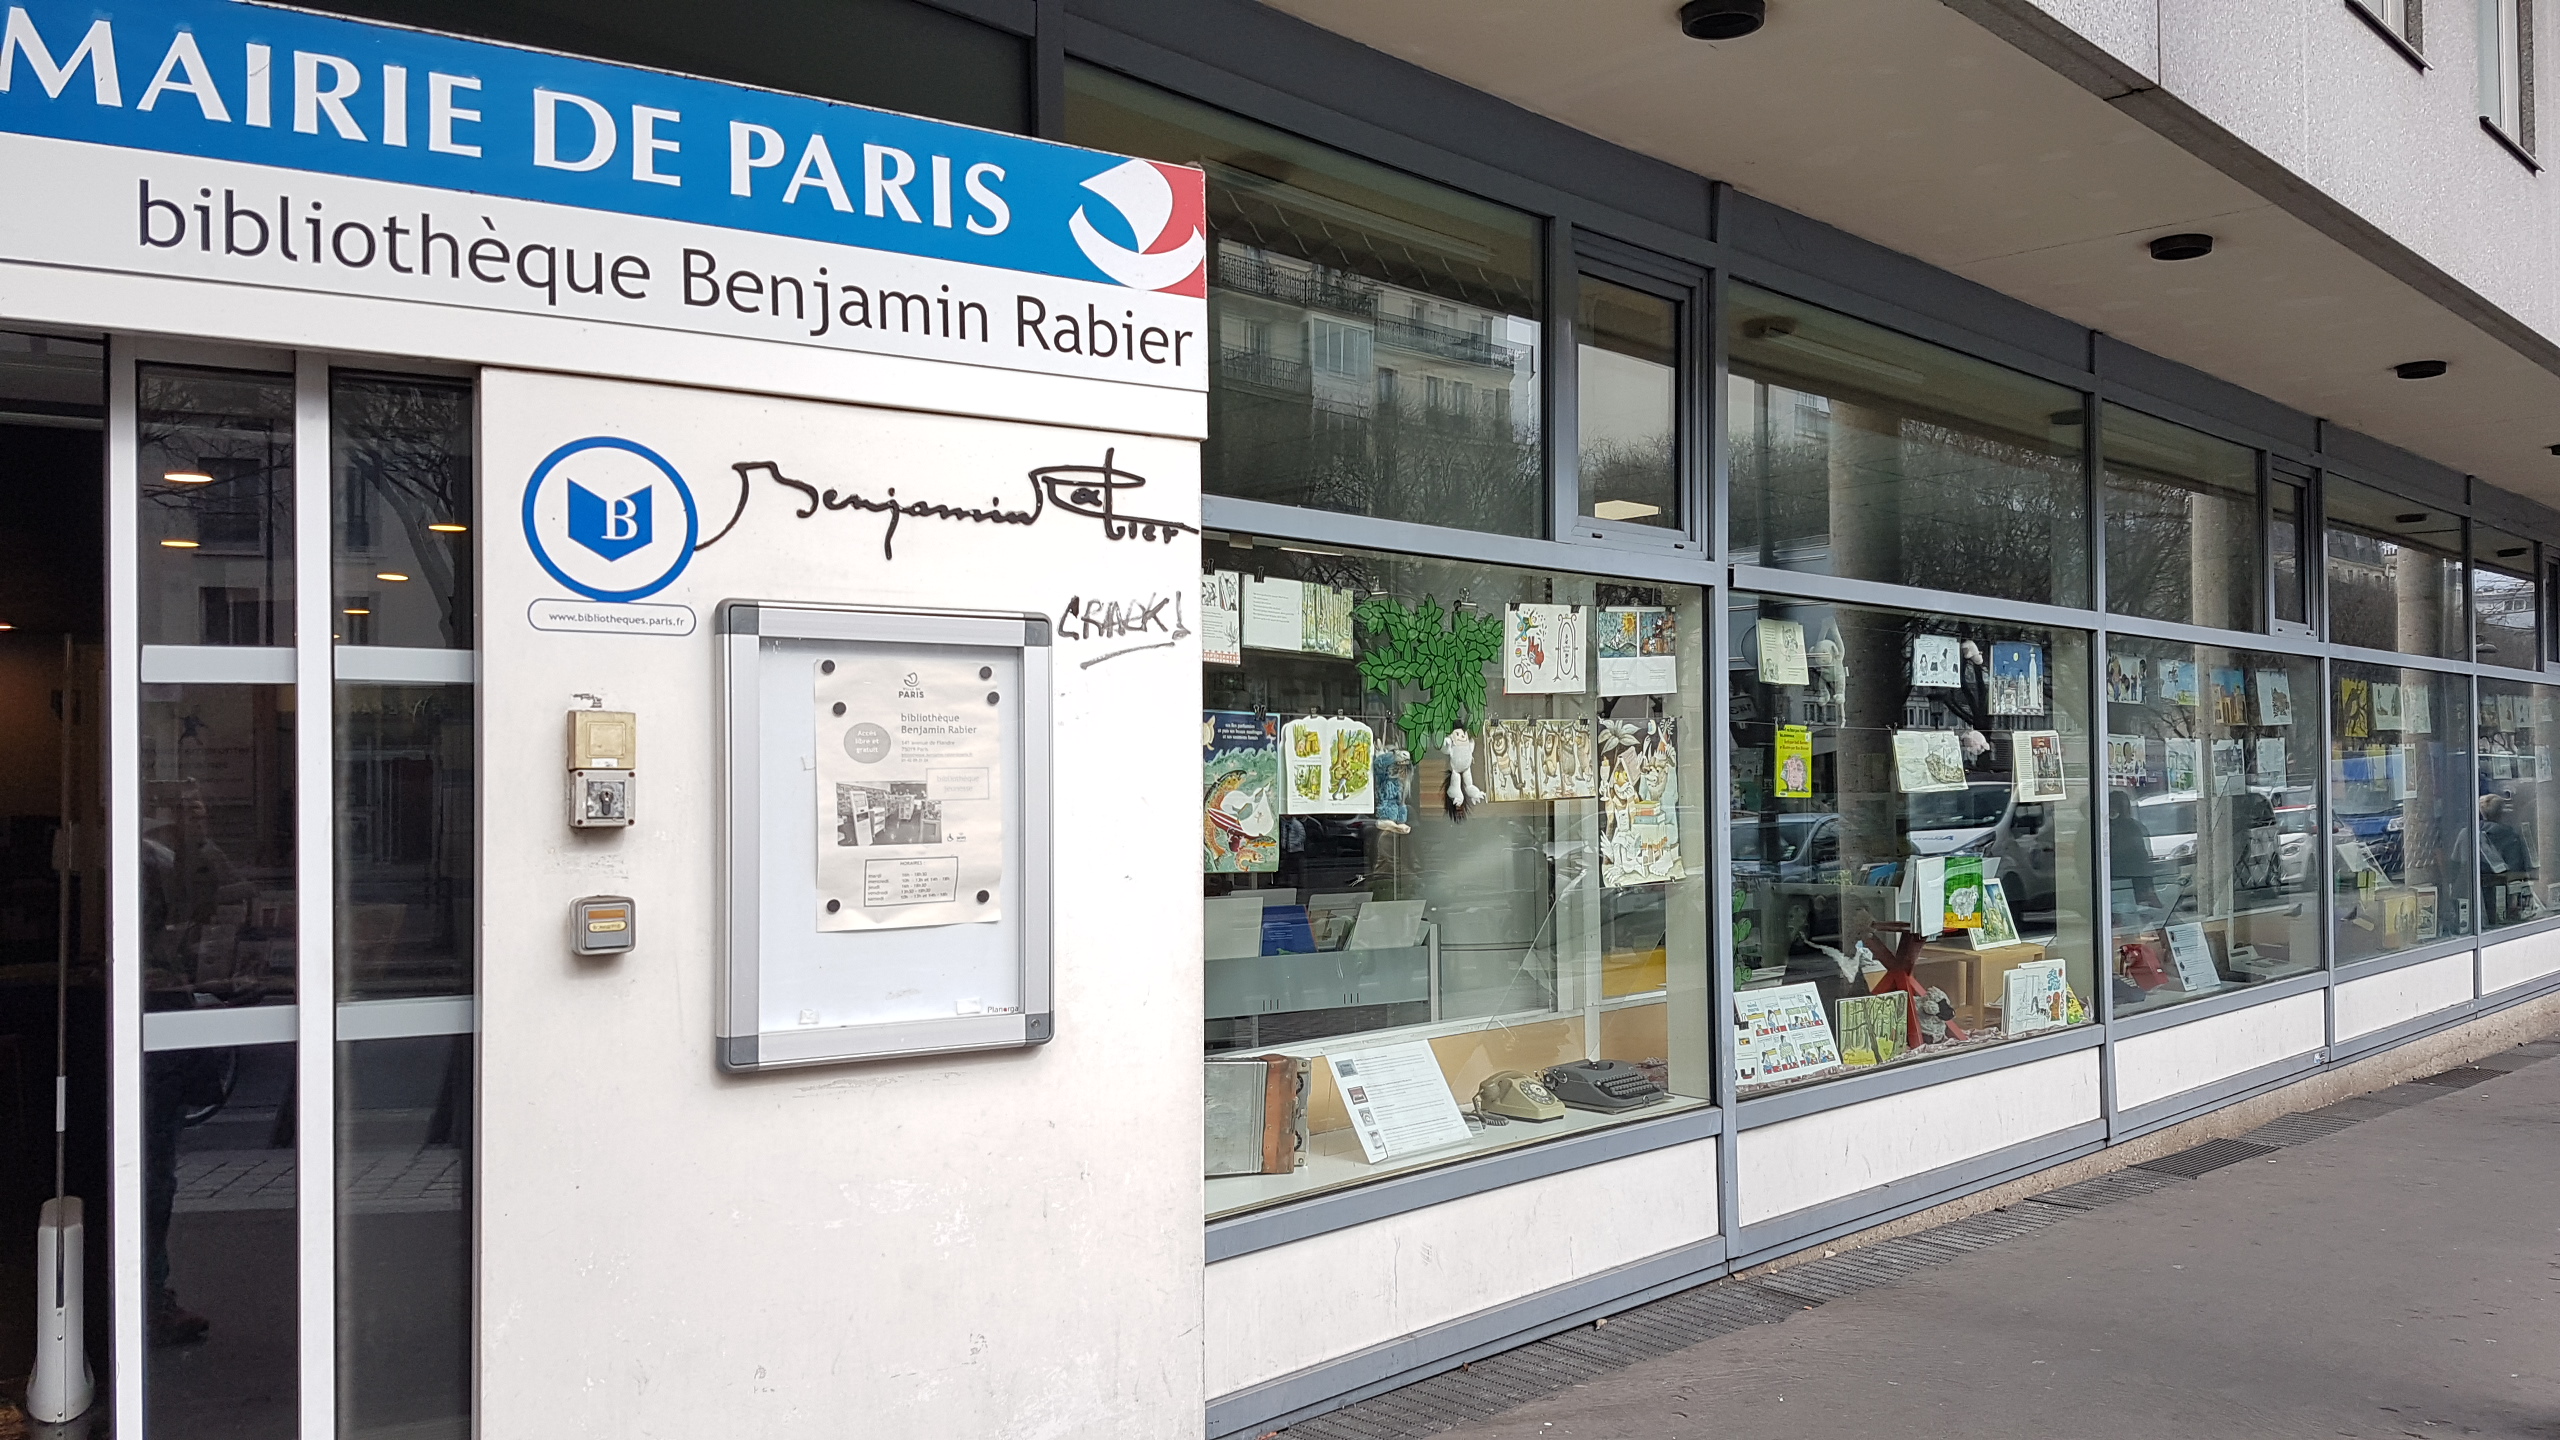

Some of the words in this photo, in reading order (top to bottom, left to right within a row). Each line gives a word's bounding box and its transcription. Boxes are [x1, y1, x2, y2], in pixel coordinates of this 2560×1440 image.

[0, 6, 483, 158] MAIRIE
[533, 87, 682, 187] DE
[729, 120, 1011, 236] PARIS
[139, 178, 652, 306] bibliothèque
[682, 247, 988, 343] Benjamin
[1017, 295, 1194, 367] Rabier
[548, 613, 685, 627] www.bibliotheques.paris.fr
[898, 690, 925, 699] PARIS
[900, 713, 960, 724] bibliothèque
[900, 725, 945, 736] Benjamin
[948, 724, 978, 734] Rabier
